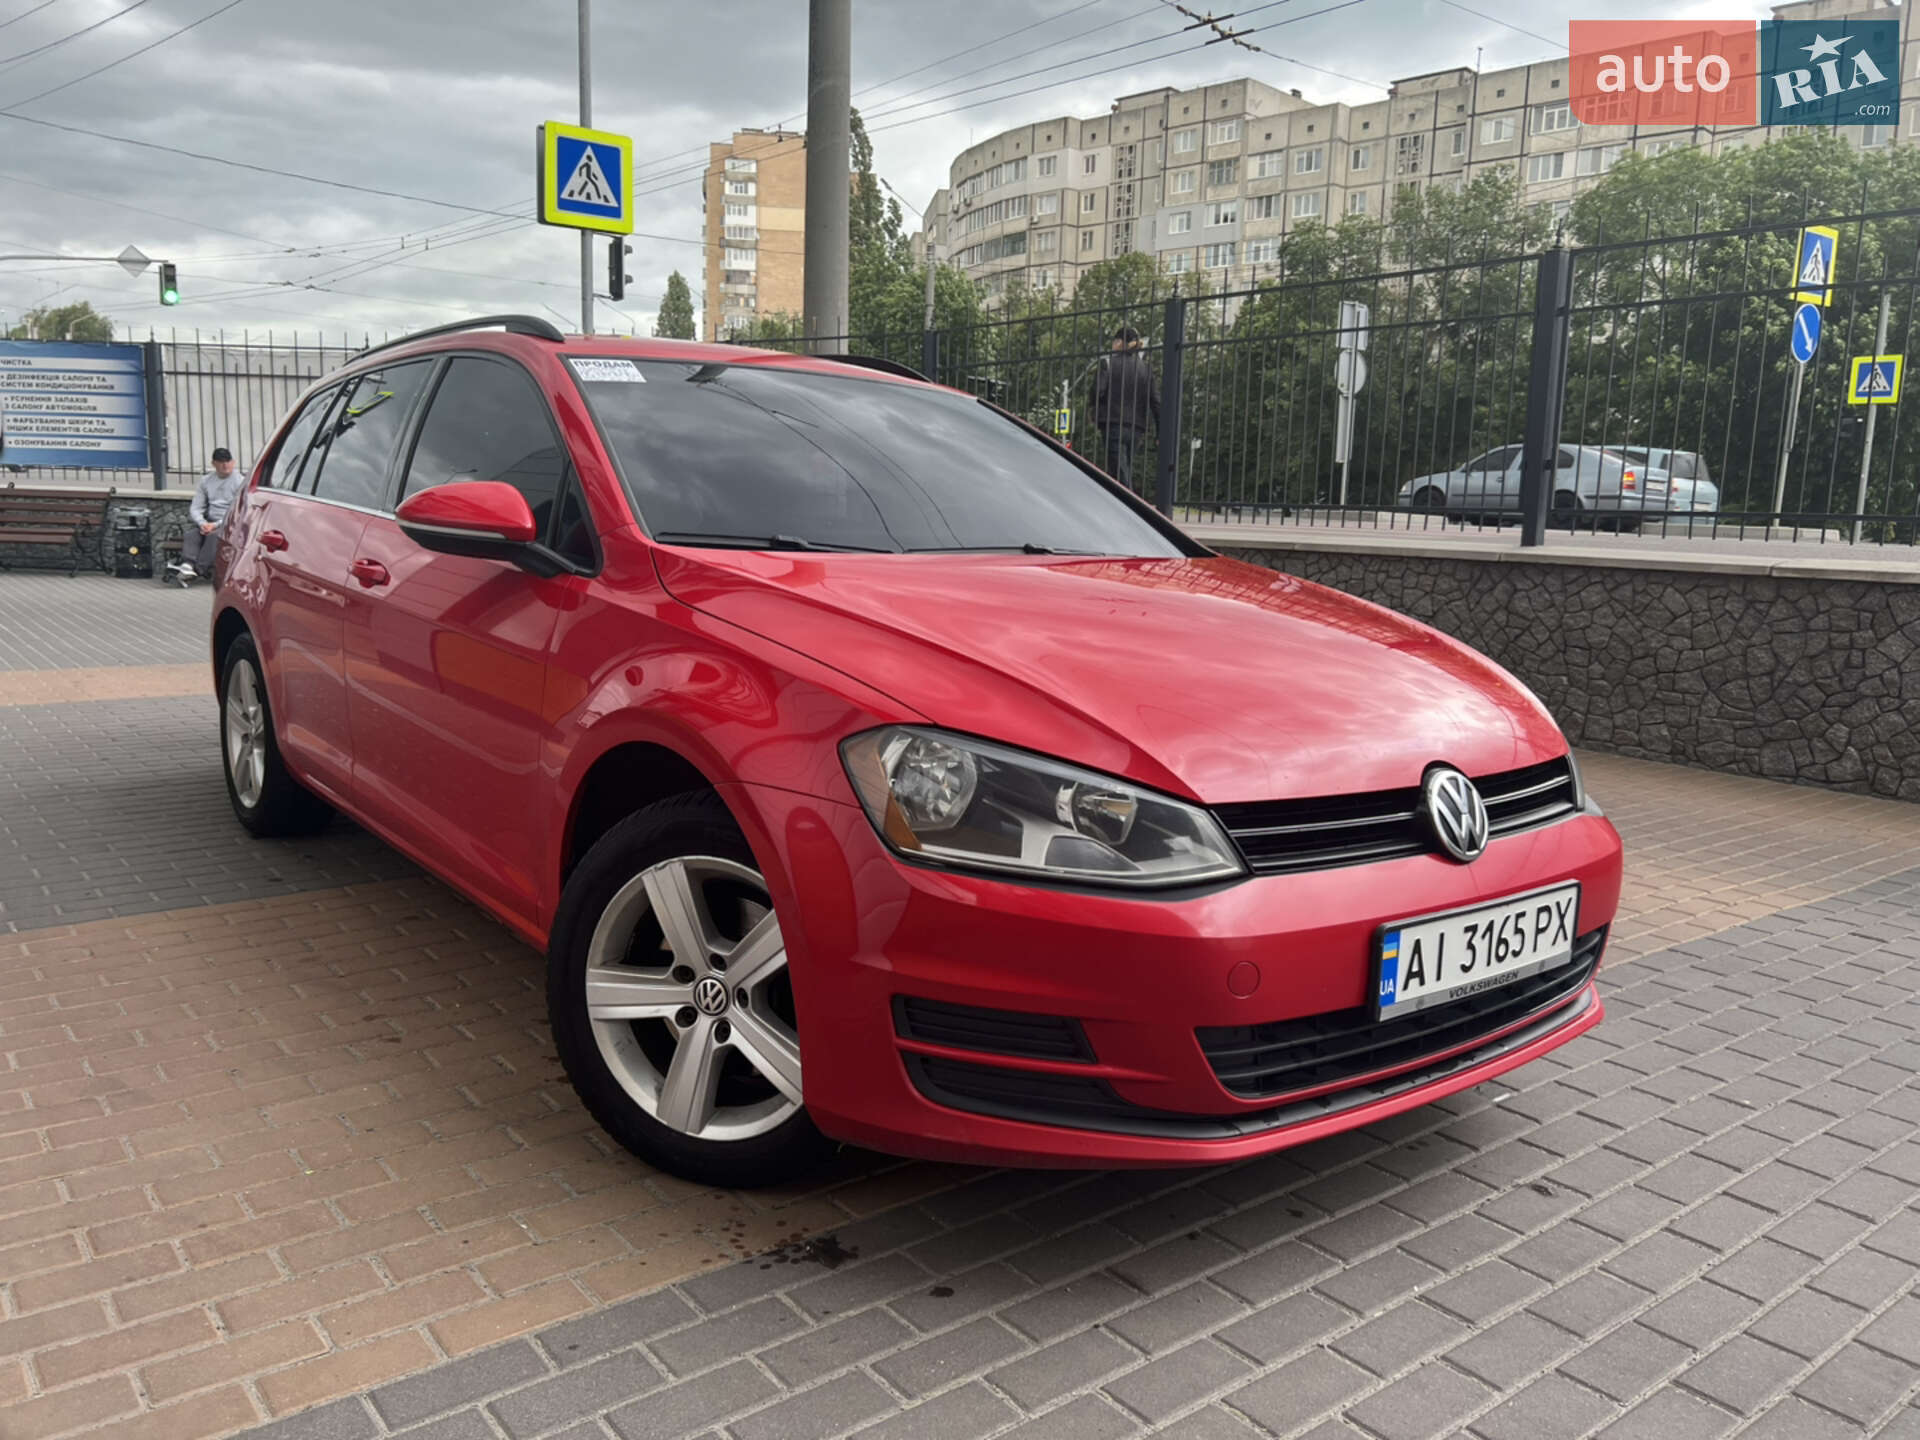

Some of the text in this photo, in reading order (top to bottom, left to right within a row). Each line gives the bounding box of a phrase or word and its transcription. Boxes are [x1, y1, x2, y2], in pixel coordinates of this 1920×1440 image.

[573, 360, 634, 368] ПРОДАМ
[62, 374, 94, 382] САЛОНУ
[1402, 897, 1573, 991] AI 3165 PX
[1380, 979, 1395, 995] UA
[1448, 969, 1520, 999] VOLKSWAGEN
